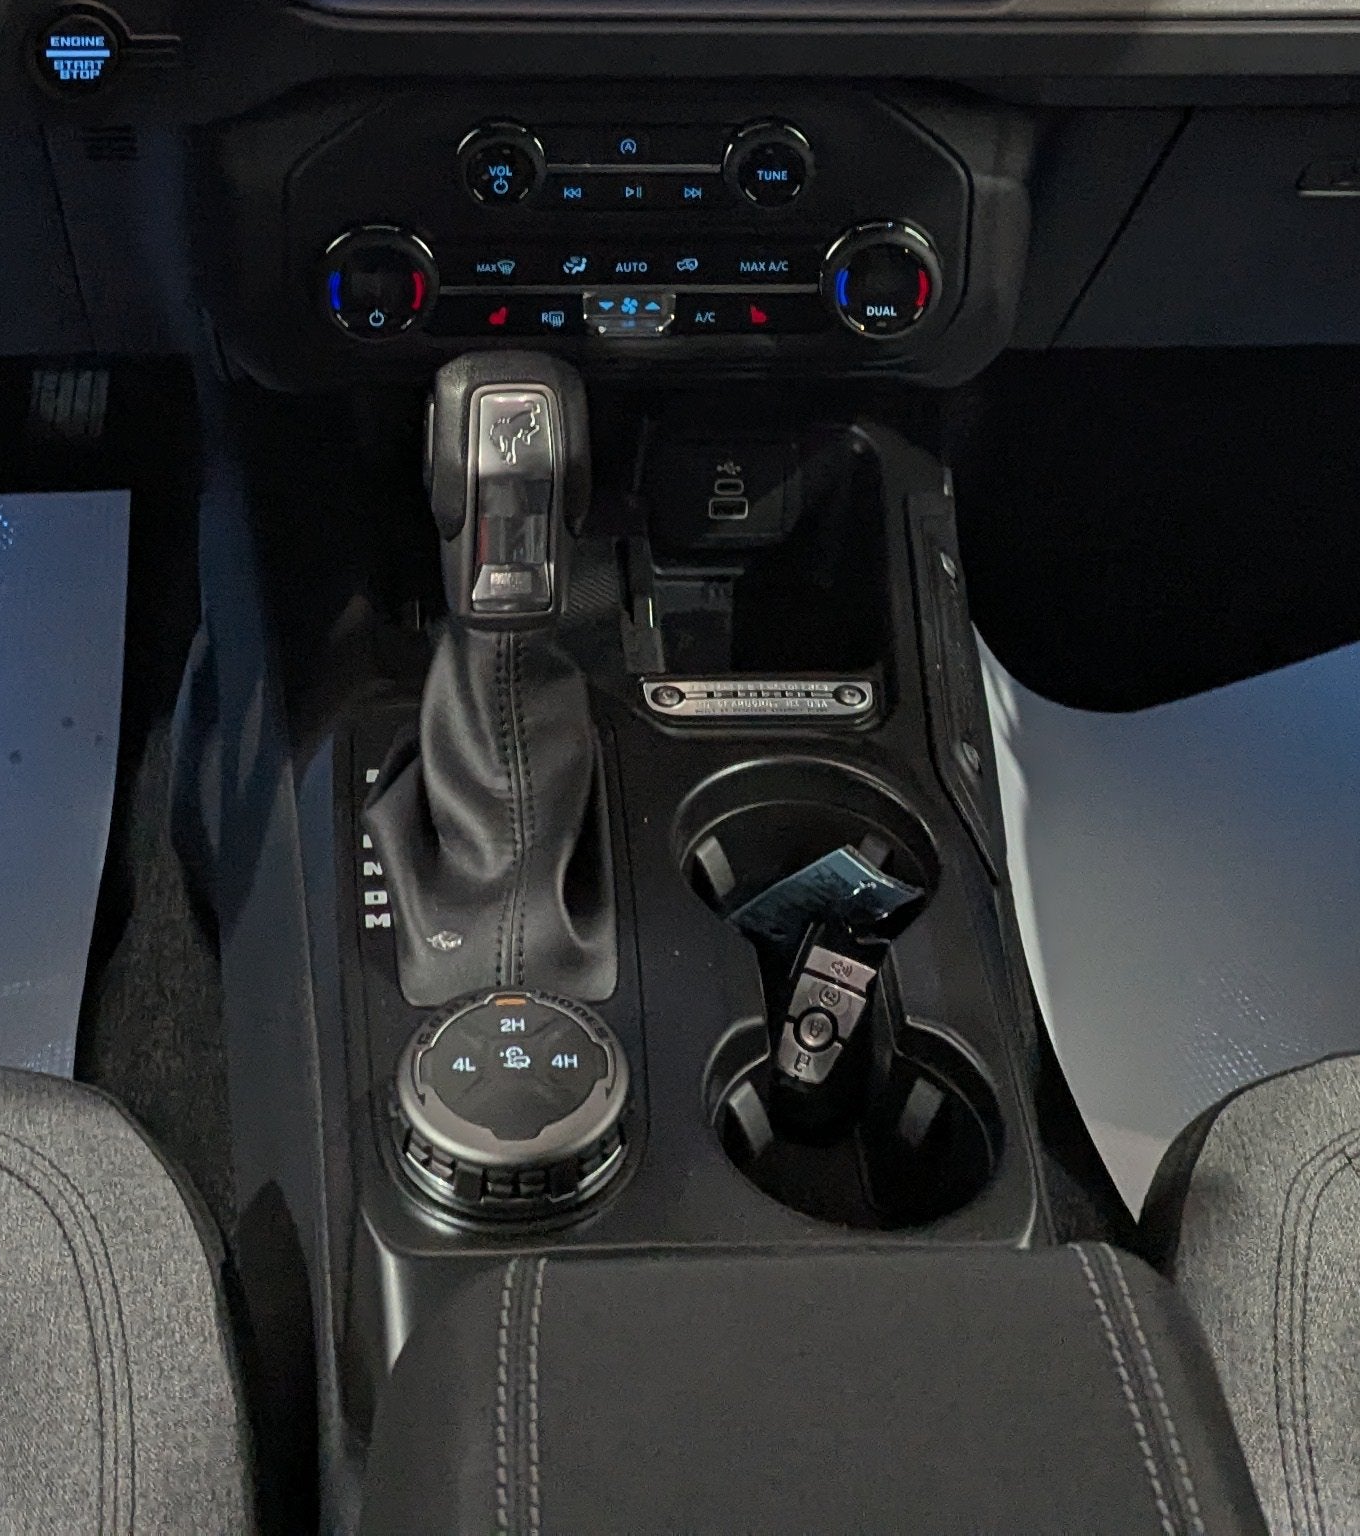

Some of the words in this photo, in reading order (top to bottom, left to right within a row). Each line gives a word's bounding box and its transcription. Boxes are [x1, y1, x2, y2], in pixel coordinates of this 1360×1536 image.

[50, 35, 105, 47] ENGINE
[53, 59, 105, 71] START
[59, 69, 100, 80] STOP
[489, 166, 512, 176] VOL
[757, 170, 788, 181] TUNE
[476, 263, 497, 273] MAX
[615, 262, 647, 273] AUTO
[740, 261, 765, 272] MAX
[768, 260, 789, 272] A/C
[695, 312, 716, 323] A/C
[866, 306, 897, 317] DUAL
[364, 890, 388, 905] D
[365, 913, 391, 929] M
[500, 1018, 526, 1033] 2H
[452, 1056, 477, 1072] 4L
[551, 1054, 578, 1069] 4H
